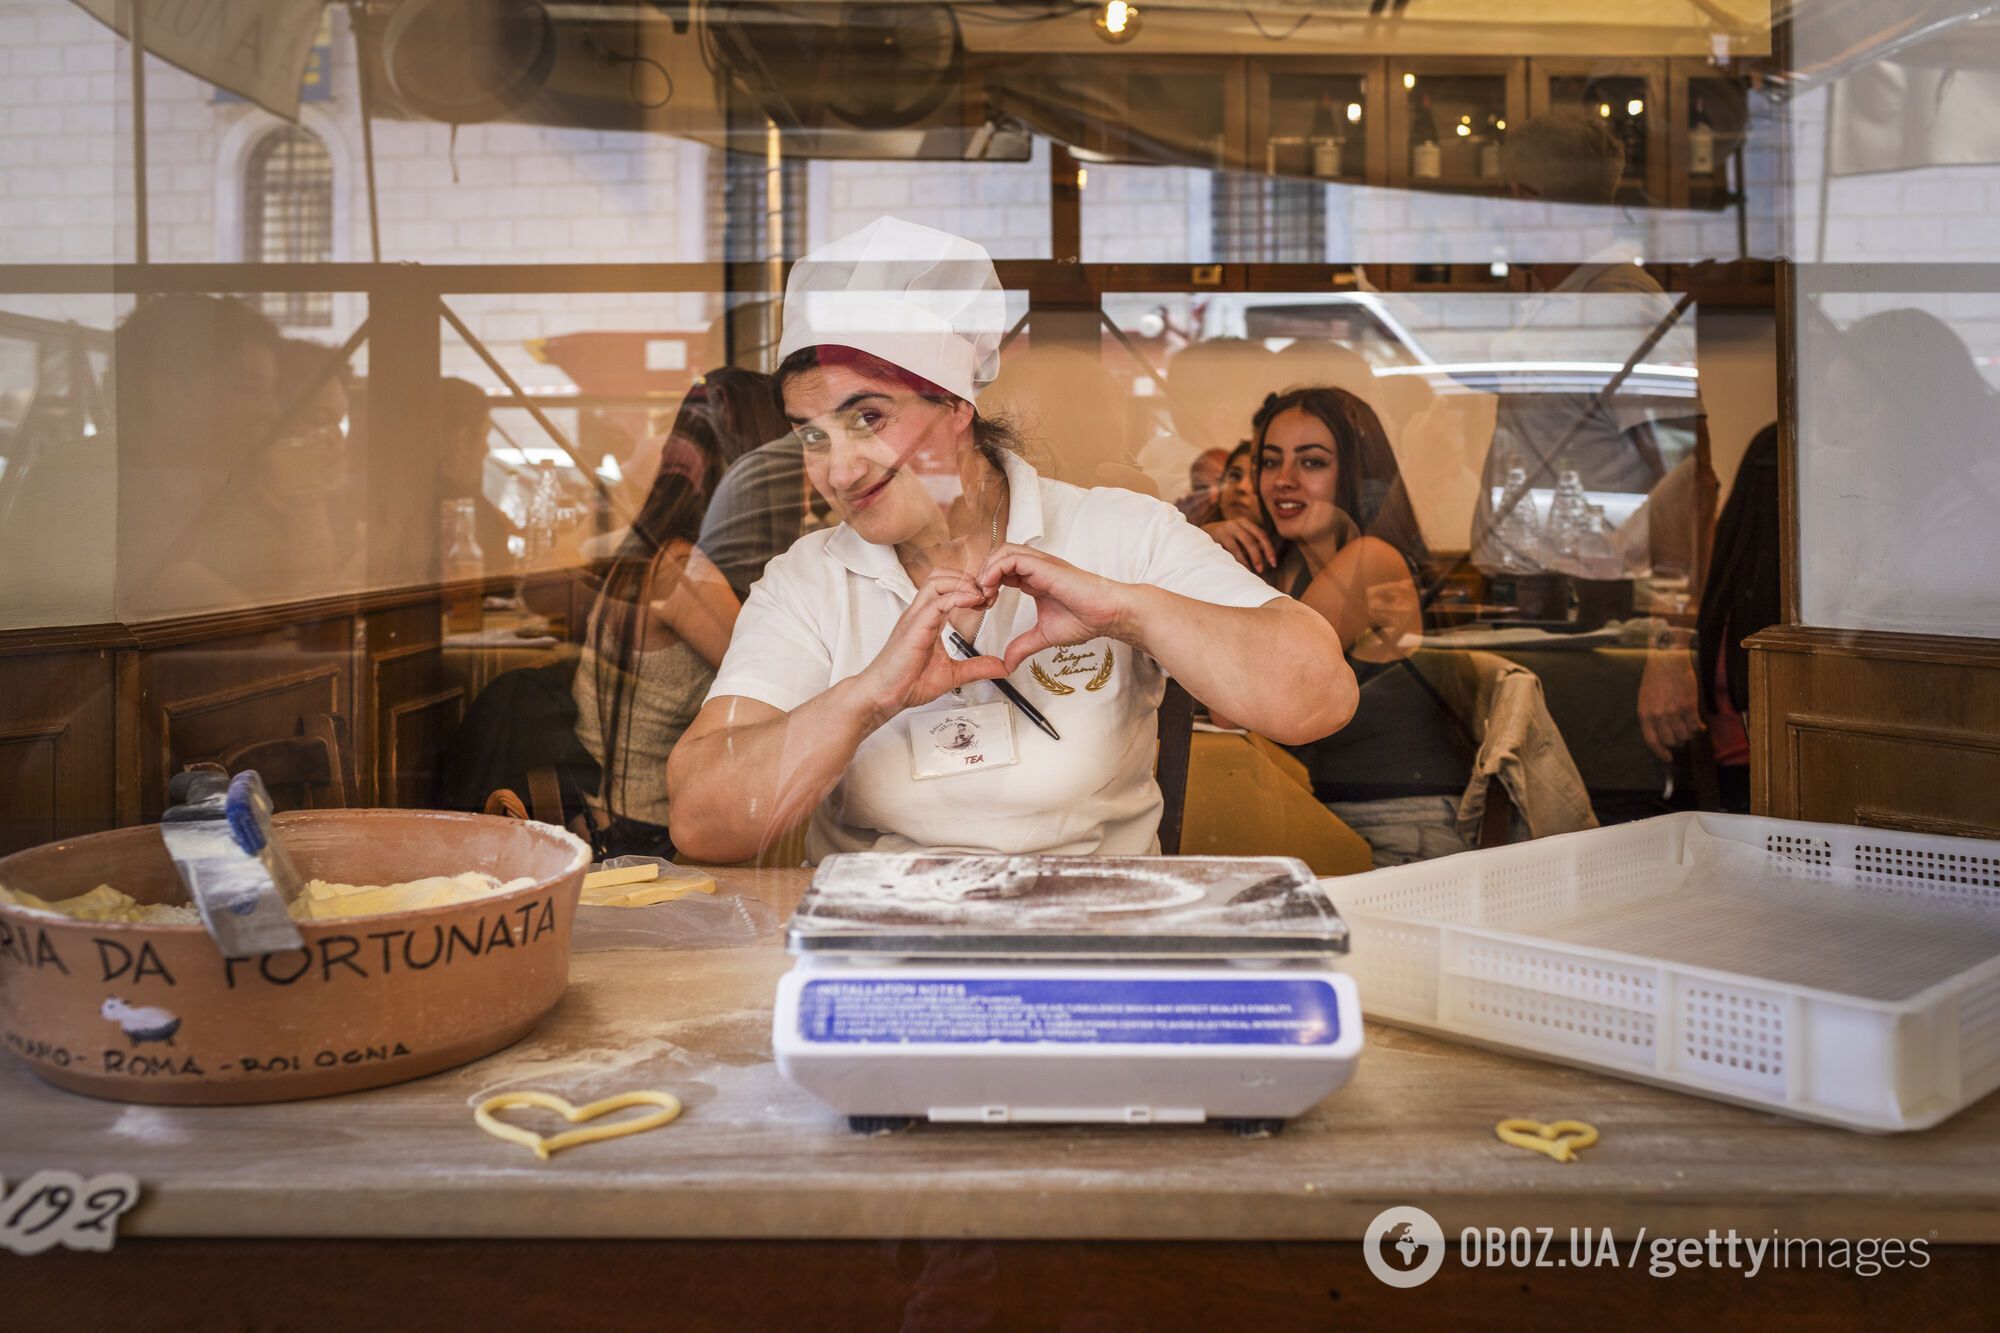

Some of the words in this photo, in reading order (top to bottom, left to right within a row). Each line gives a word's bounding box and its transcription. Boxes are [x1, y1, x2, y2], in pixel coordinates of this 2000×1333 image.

[964, 754, 985, 765] TEA
[92, 936, 176, 986] DA
[917, 984, 967, 996] NOTES
[103, 1049, 205, 1077] ROMA
[5, 1185, 128, 1237] 192
